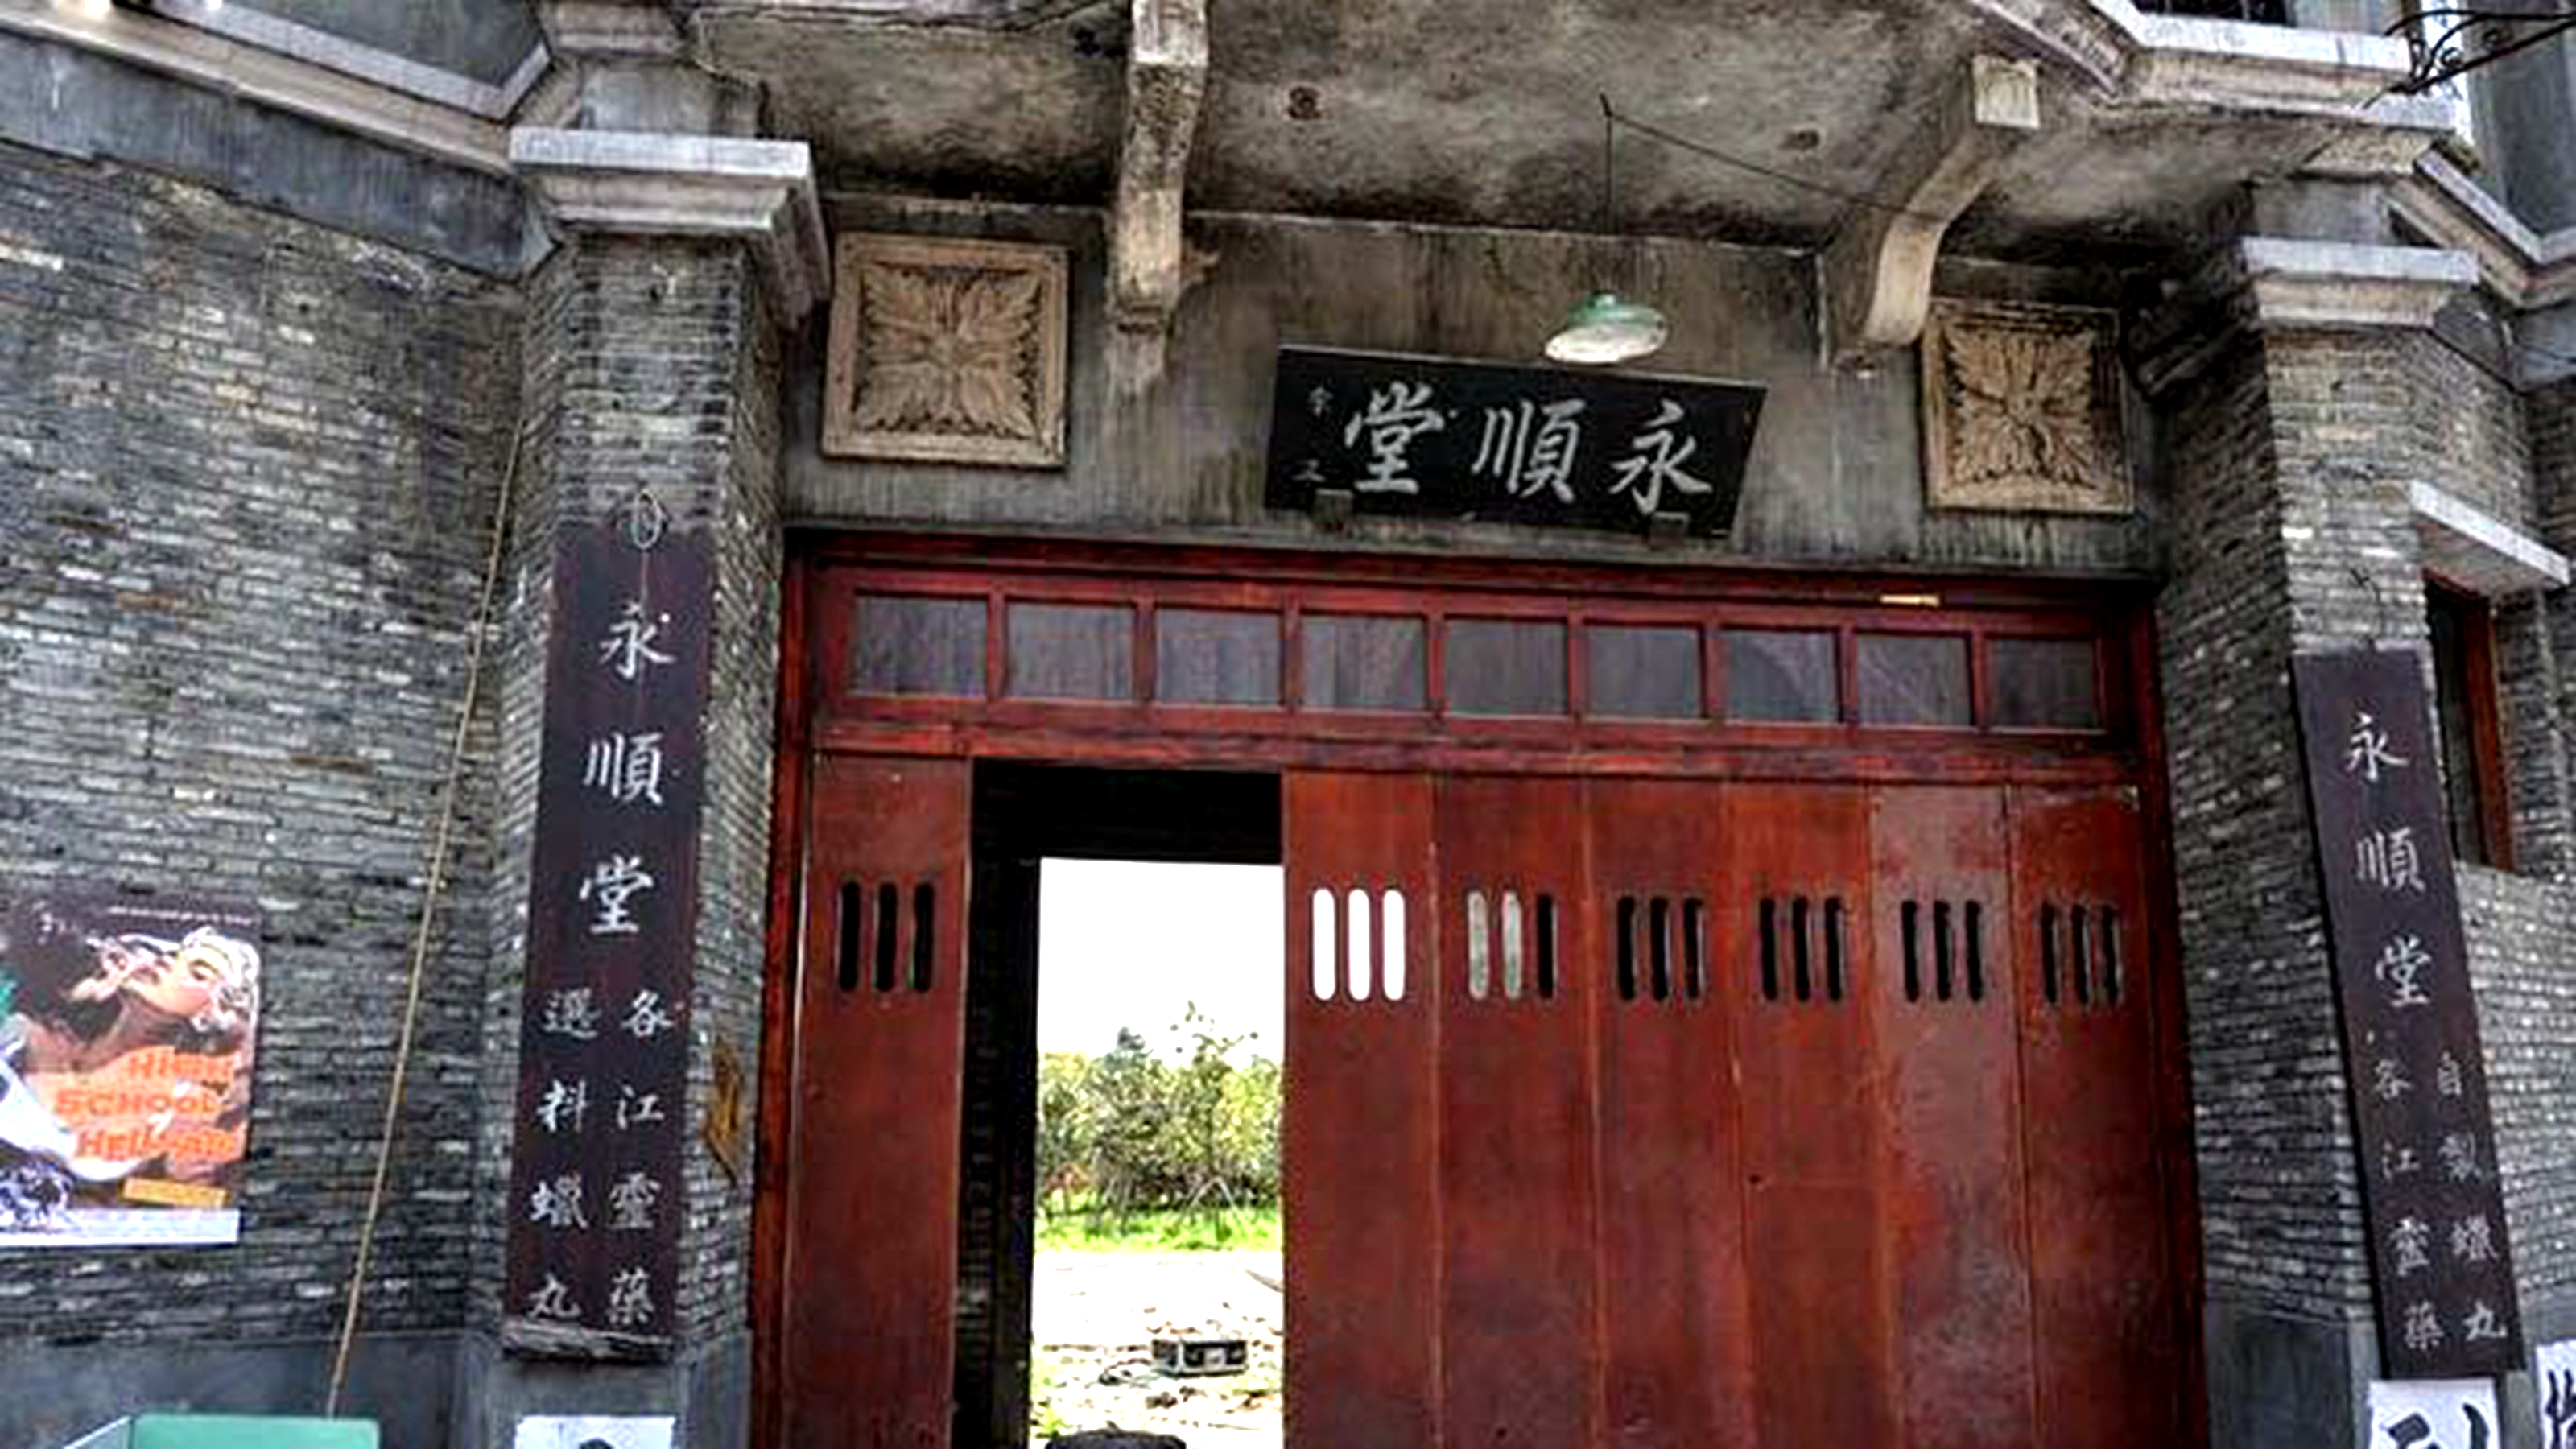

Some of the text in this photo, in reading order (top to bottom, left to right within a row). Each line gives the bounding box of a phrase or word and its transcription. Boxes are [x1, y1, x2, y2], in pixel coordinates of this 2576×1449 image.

[579, 601, 676, 935] 永順堂
[2345, 712, 2432, 1008] 永順堂
[56, 1087, 219, 1117] SCHOOL
